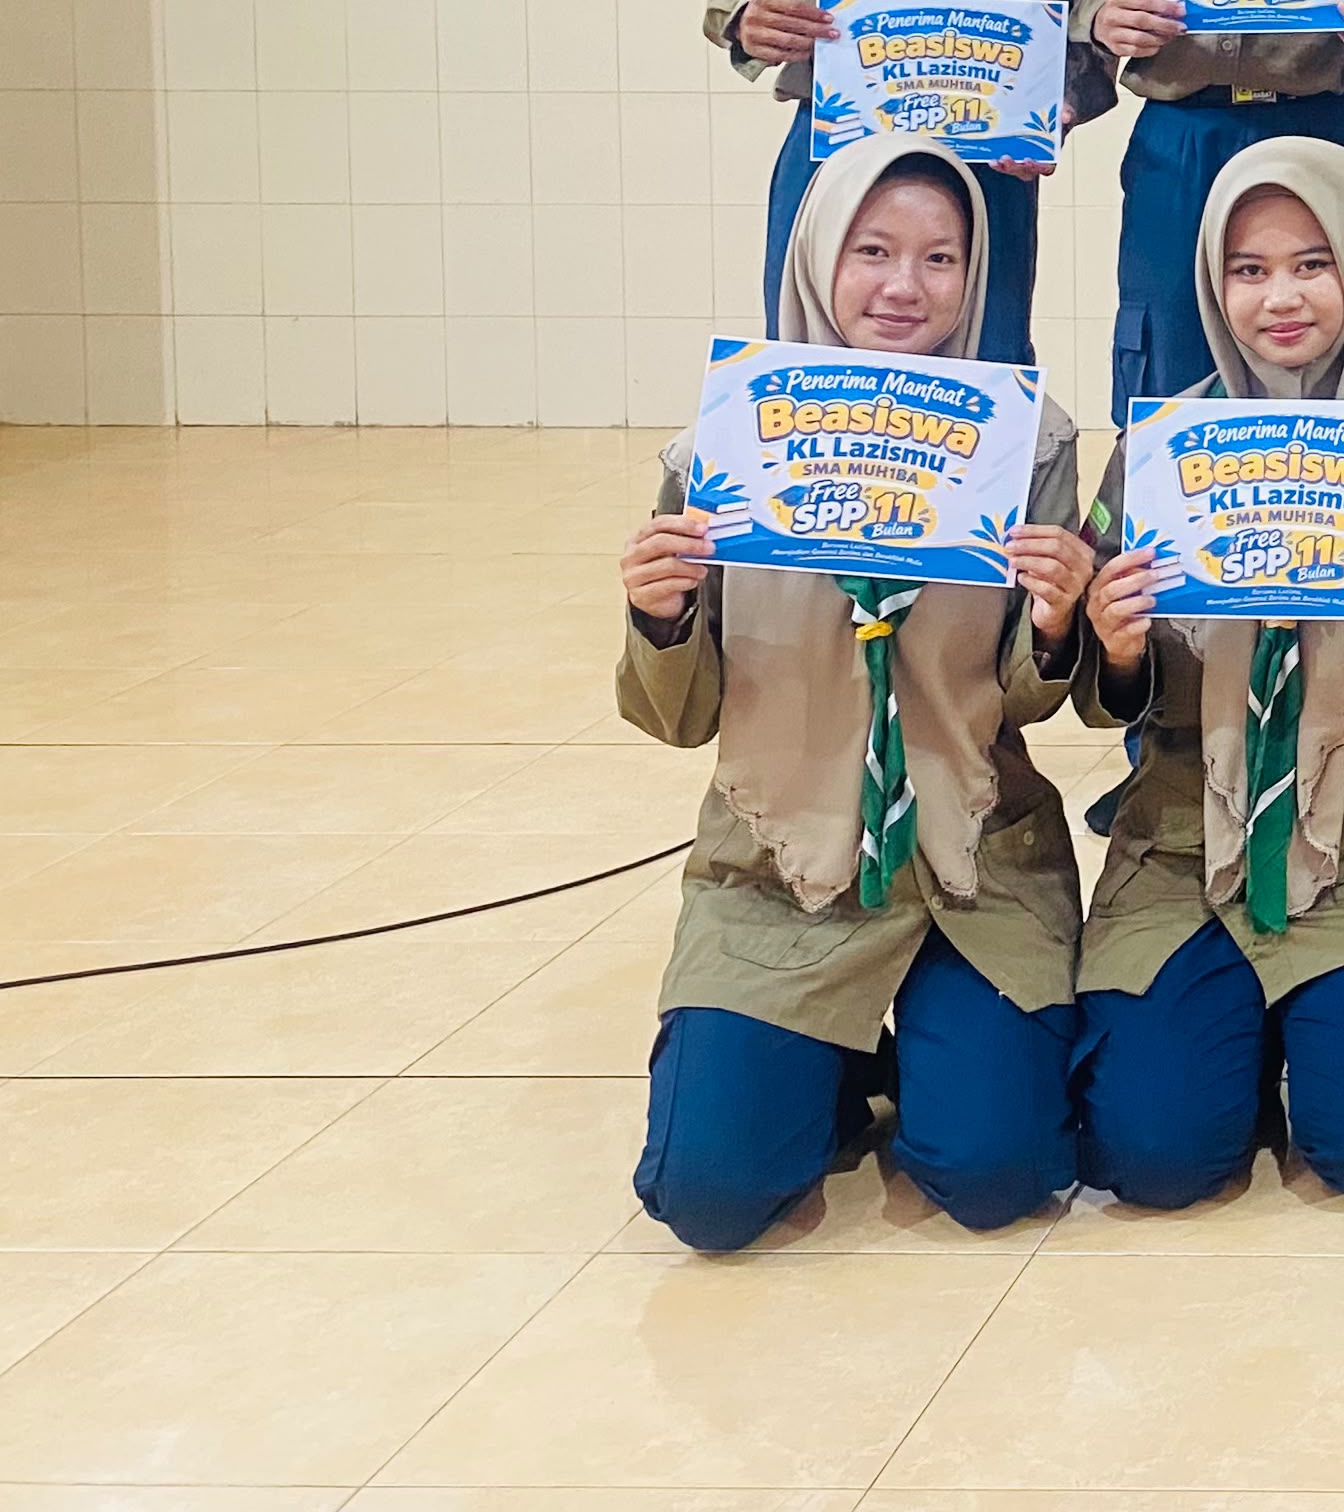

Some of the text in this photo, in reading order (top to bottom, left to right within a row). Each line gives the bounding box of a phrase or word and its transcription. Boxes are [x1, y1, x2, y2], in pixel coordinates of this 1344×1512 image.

[877, 11, 1009, 33] Penerima Manfaat
[858, 31, 1023, 69] Beasiswa
[883, 61, 1000, 82] KL Lazismu
[896, 81, 924, 92] SMA
[903, 94, 940, 110] Free
[894, 98, 980, 132] SPP 11
[786, 370, 965, 406] Penerima Manfaat
[757, 397, 980, 459] Beasiswa
[1203, 420, 1288, 448] Penerima
[786, 438, 946, 473] KL Lazismu
[802, 462, 840, 476] SMA
[810, 480, 859, 502] Free
[1210, 489, 1245, 513] KL
[791, 492, 916, 533] SPP 11
[1226, 512, 1261, 527] SMA
[871, 522, 914, 538] Bulan
[1234, 529, 1280, 549] Free
[1221, 535, 1334, 583] SPP 11
[1297, 566, 1336, 582] Bulan
